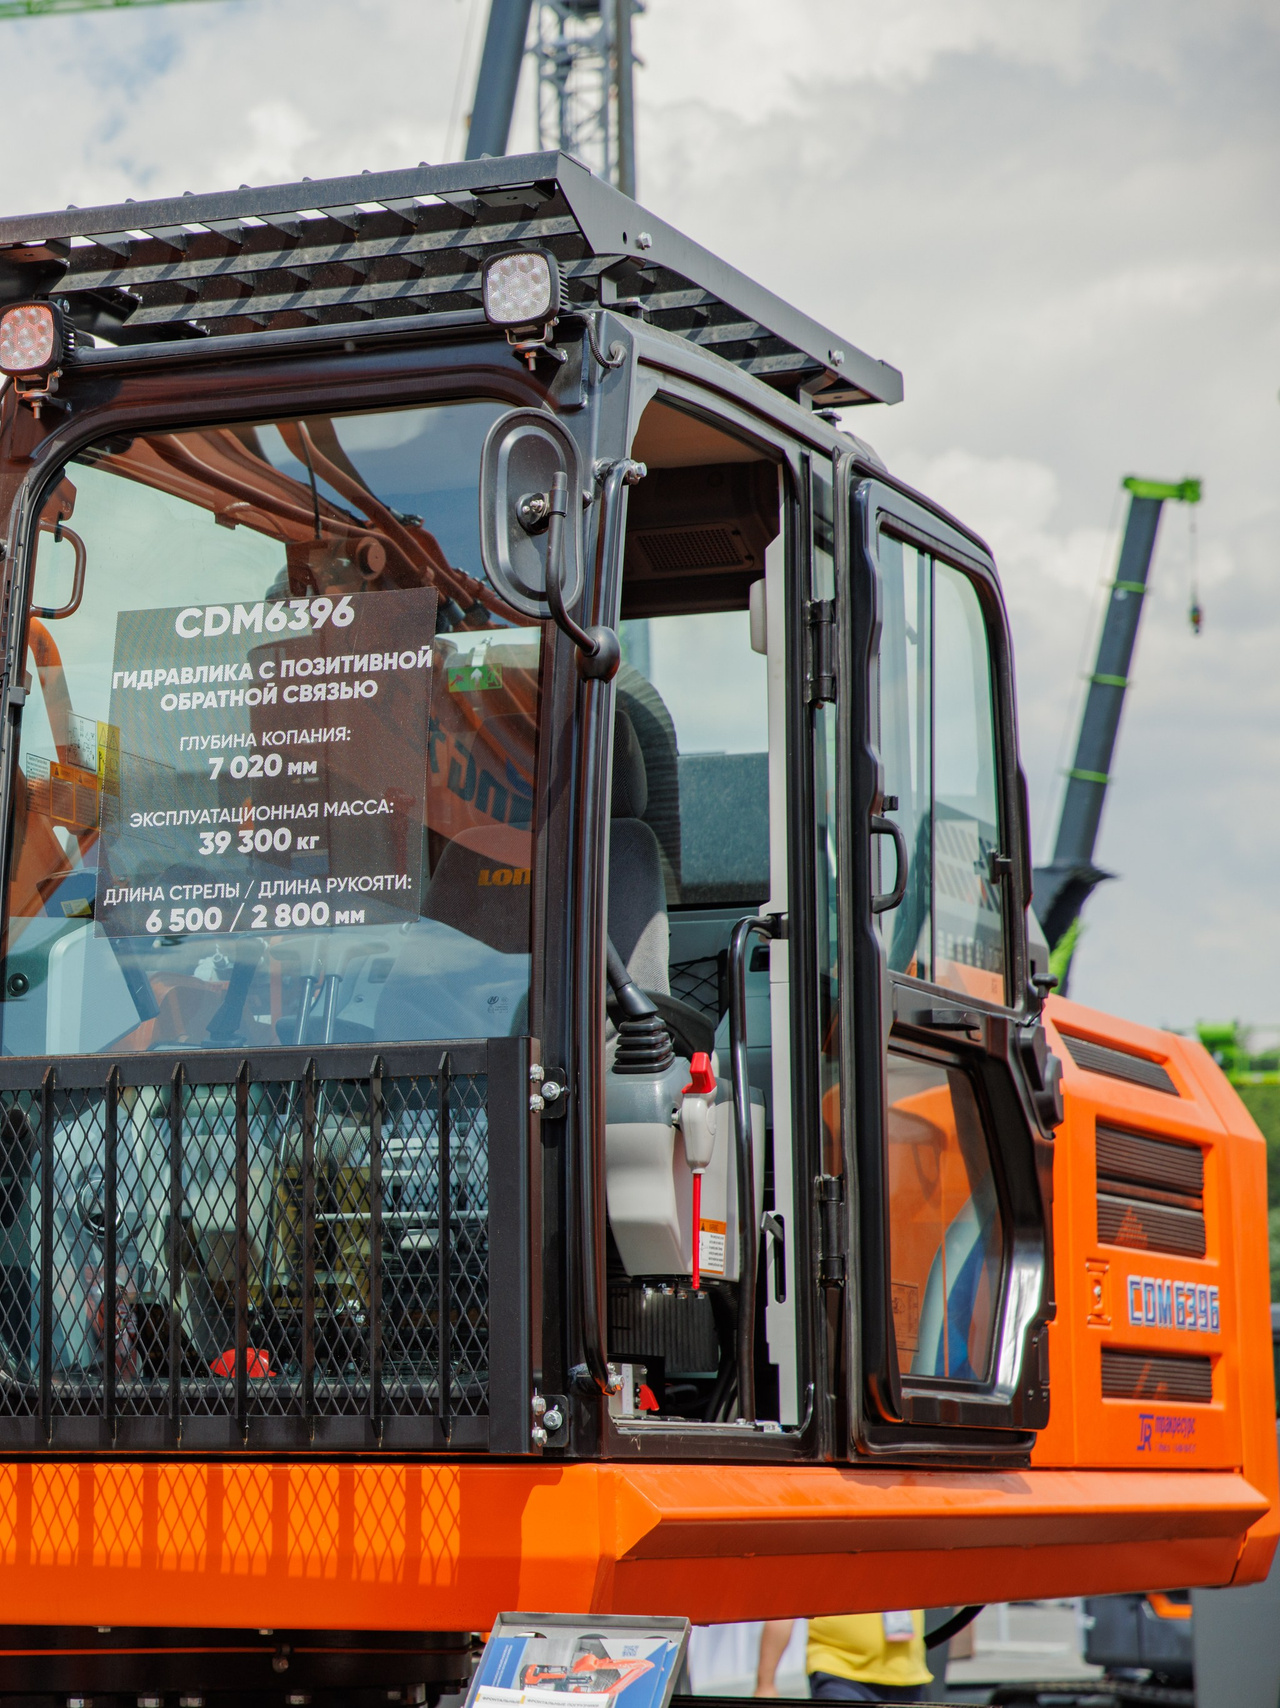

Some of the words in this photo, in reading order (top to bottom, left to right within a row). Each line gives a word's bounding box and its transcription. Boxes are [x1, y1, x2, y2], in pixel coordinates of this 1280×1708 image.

[175, 596, 355, 639] CDM6396
[112, 663, 254, 690] ГИДРАВЛИКА
[258, 661, 276, 679] С
[280, 645, 433, 678] ПОЗИТИВНОЙ
[160, 683, 278, 711] ОБРАТНОЙ
[283, 679, 378, 704] СВЯЗЬЮ
[179, 732, 257, 752] ГЛУБИНА
[261, 726, 351, 746] КОПАНИЯ:
[208, 756, 225, 780] 7
[229, 753, 283, 779] 020
[287, 760, 317, 776] мм
[130, 802, 318, 828] ЭКСПЛУАТАЦИОННАЯ
[323, 798, 394, 817] МАССА:
[198, 830, 232, 856] 39
[237, 827, 292, 854] 300
[297, 835, 320, 850] кг
[103, 886, 165, 906] ДЛИНА
[169, 882, 240, 901] СТРЕЛЫ
[244, 879, 255, 899] /
[257, 878, 322, 899] ДЛИНА
[326, 874, 412, 893] РУКОЯТИ:
[145, 909, 163, 933] 6
[168, 906, 223, 932] 500
[229, 902, 245, 933] /
[250, 904, 268, 929] 2
[274, 901, 330, 928] 800
[334, 909, 366, 925] мм
[1127, 1274, 1221, 1335] CDM6396
